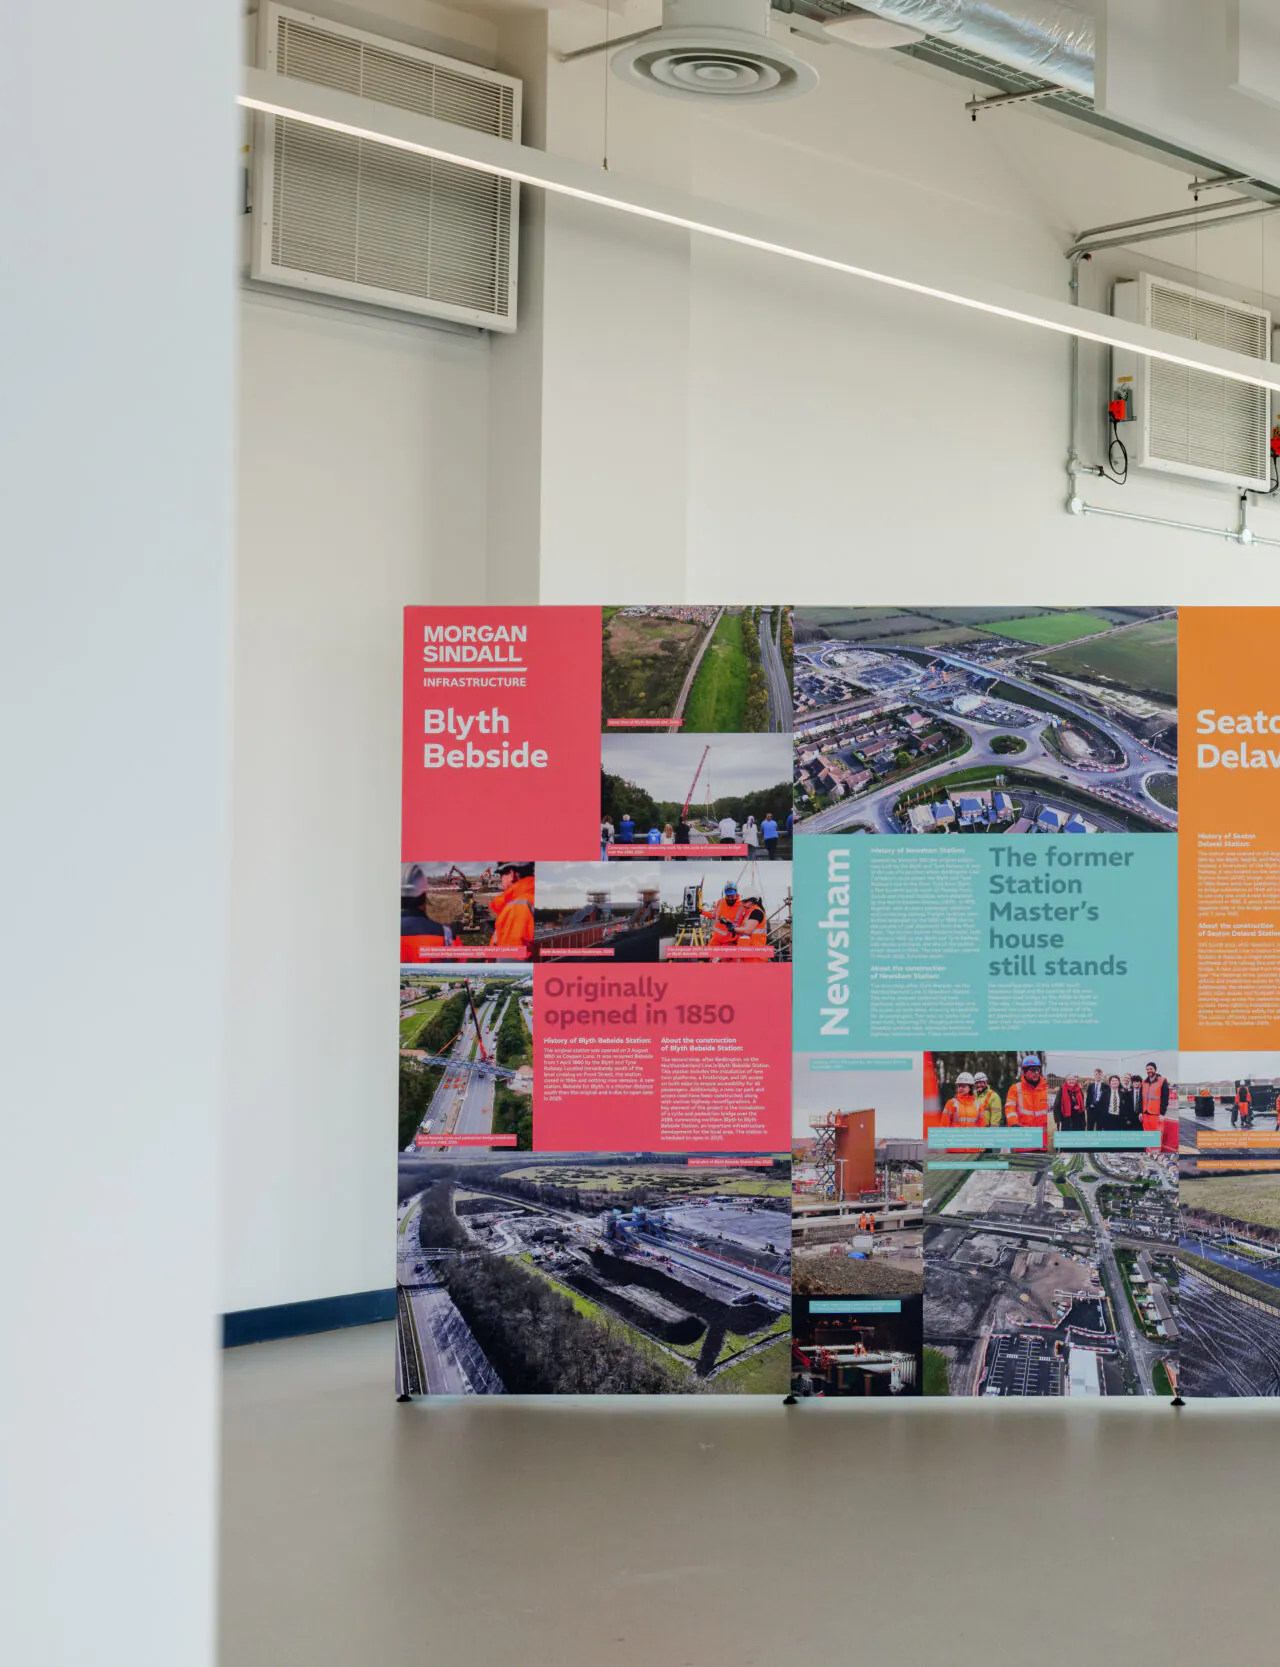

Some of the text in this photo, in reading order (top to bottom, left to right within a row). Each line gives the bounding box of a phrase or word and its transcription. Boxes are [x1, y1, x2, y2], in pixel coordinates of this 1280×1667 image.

[424, 626, 527, 642] MORGAN
[424, 646, 522, 662] SINDALL
[424, 678, 526, 687] INFRASTRUCTURE
[424, 707, 510, 737] Blyth
[424, 742, 548, 768] Bebside
[988, 846, 1134, 867] The former
[988, 872, 1082, 894] Station
[990, 900, 1100, 922] Master’s
[818, 848, 850, 1035] Newsham
[989, 926, 1064, 949] house
[988, 954, 1128, 976] still stands
[544, 976, 668, 1002] Originally
[544, 1003, 735, 1029] opened in 1850
